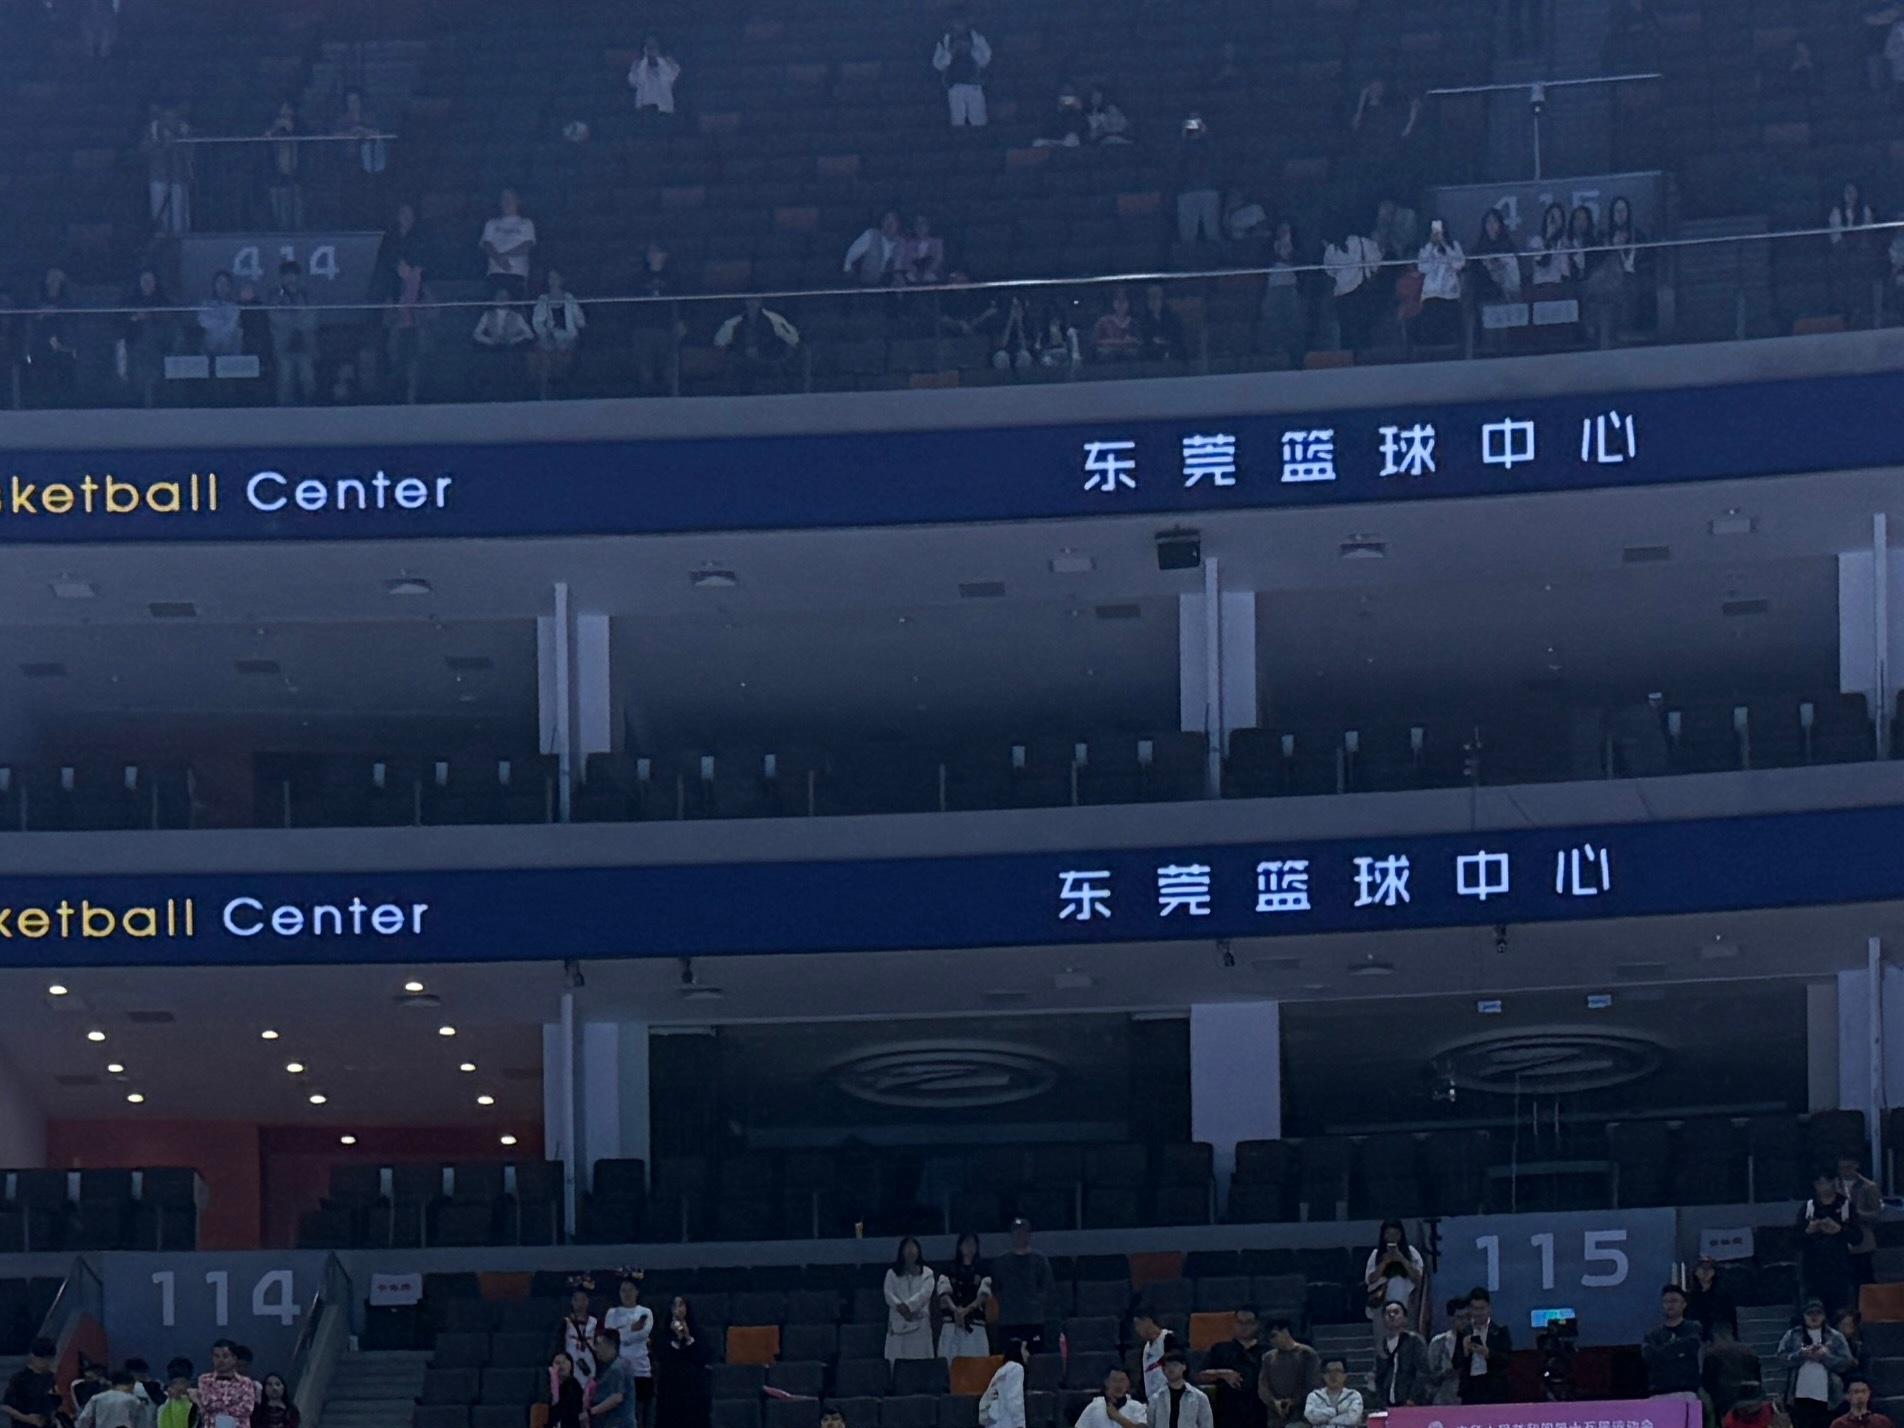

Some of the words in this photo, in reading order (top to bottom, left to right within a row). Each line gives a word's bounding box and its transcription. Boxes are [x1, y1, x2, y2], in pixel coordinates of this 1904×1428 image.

[1081, 410, 1638, 492] 东莞篮球中心
[246, 470, 453, 512] Center
[1057, 843, 1610, 922] 东莞篮球中心
[223, 896, 429, 937] Center
[1476, 1229, 1629, 1292] 115
[152, 1270, 301, 1326] 114
